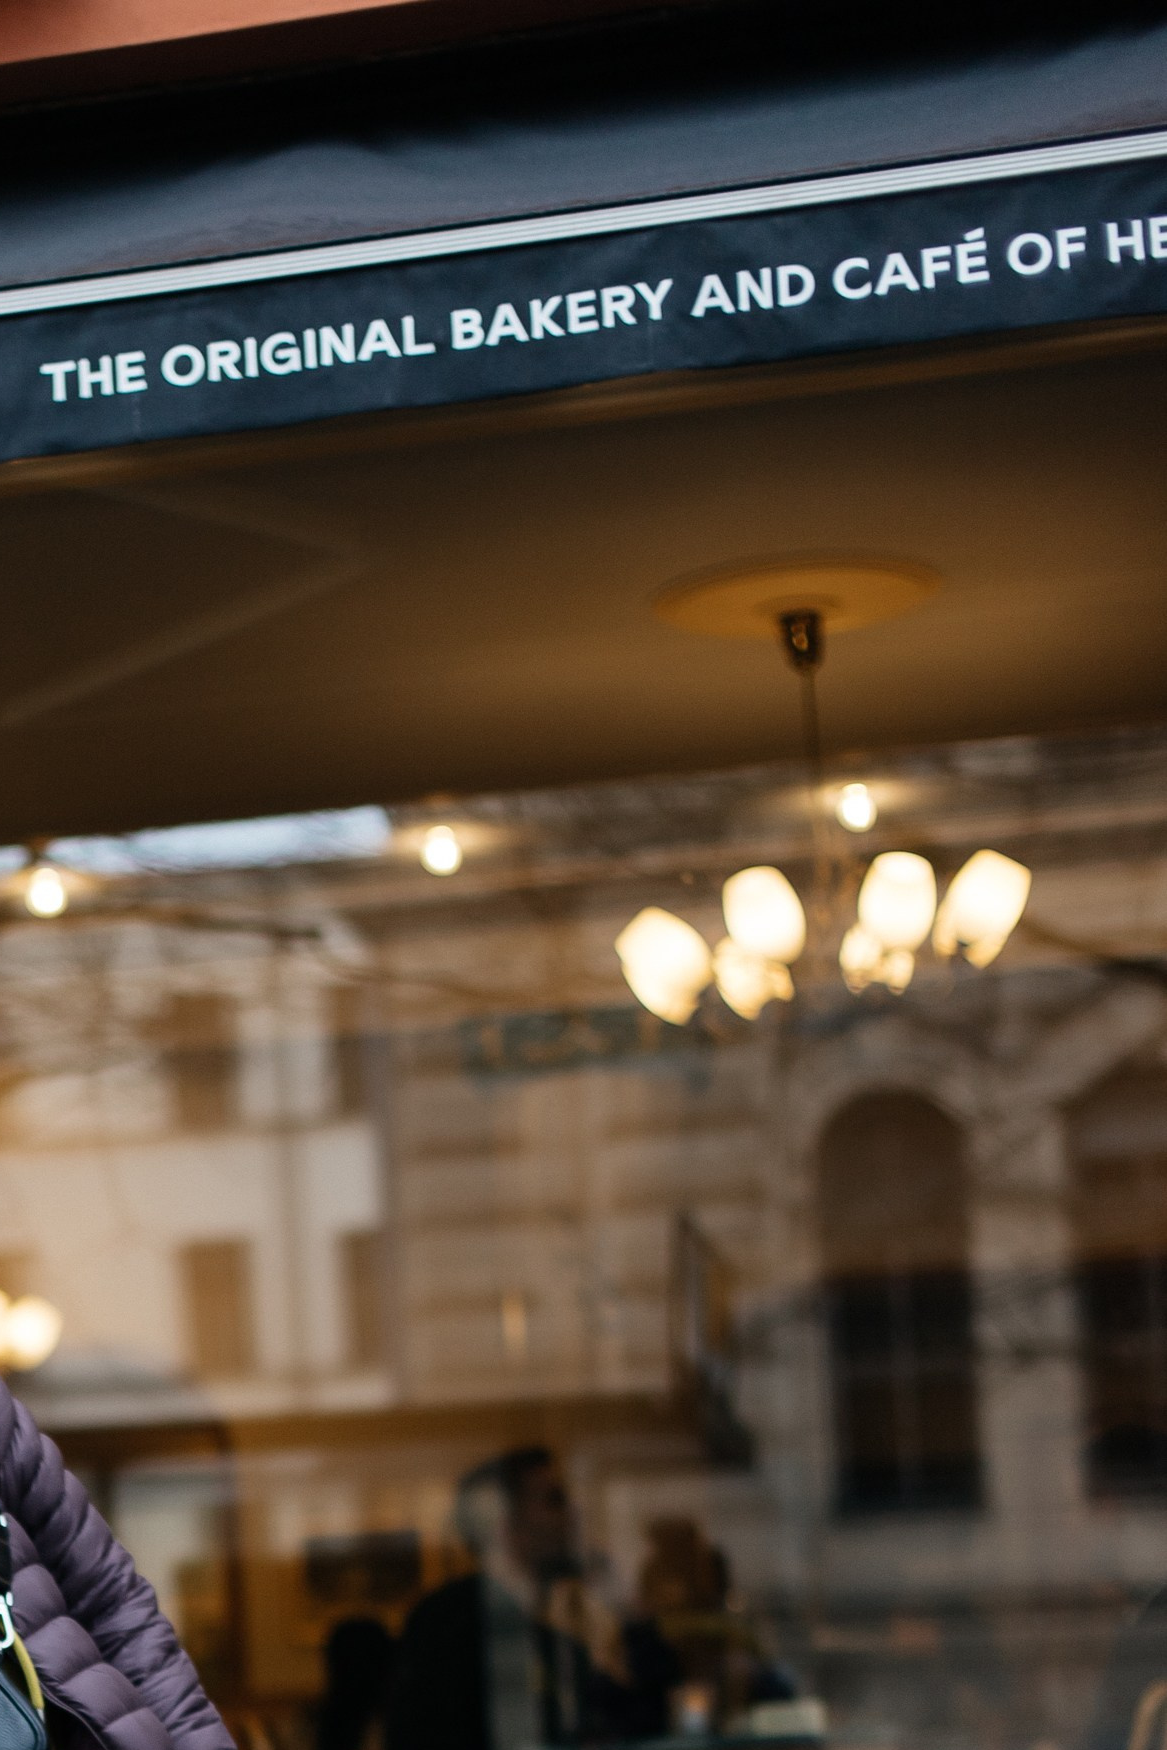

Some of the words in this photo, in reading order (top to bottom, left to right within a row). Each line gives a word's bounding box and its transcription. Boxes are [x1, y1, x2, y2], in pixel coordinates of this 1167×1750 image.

[39, 350, 148, 402] THE
[160, 315, 436, 387] ORIGINAL
[450, 278, 673, 350] BAKERY
[690, 264, 816, 318] AND
[832, 227, 991, 300] CAFÉ
[1006, 226, 1087, 276] OF
